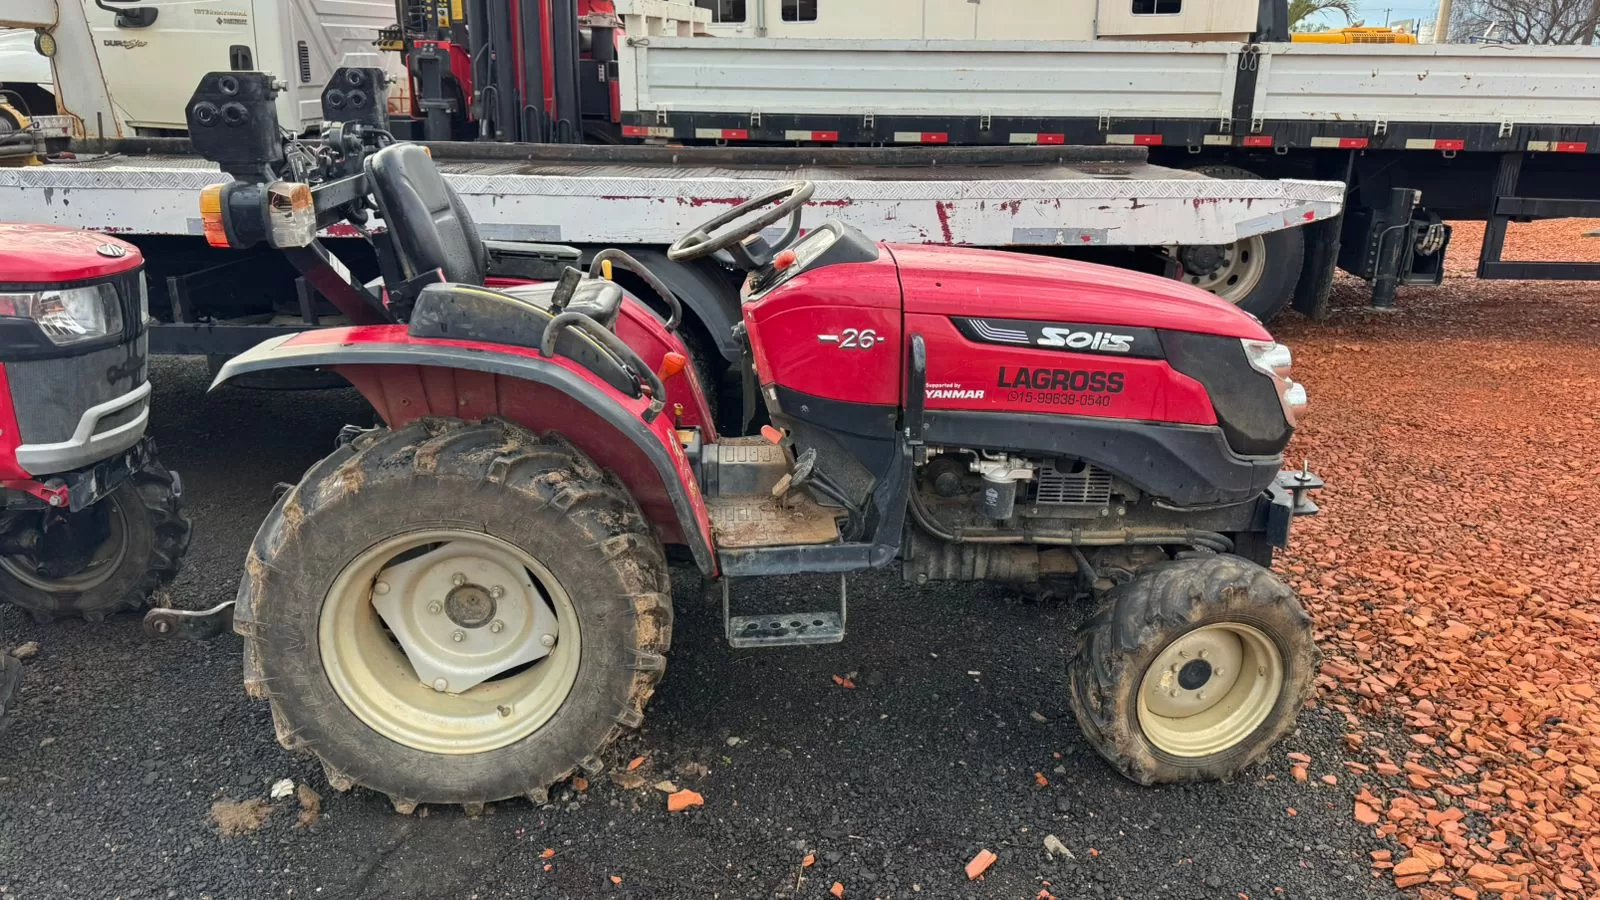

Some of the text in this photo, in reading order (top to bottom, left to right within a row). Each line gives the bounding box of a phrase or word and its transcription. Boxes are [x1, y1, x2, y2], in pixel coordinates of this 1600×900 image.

[193, 8, 248, 17] INTERNATIONAL
[1036, 326, 1136, 353] Solis
[997, 366, 1126, 394] LAGROSS
[925, 389, 985, 399] YANMAR
[1018, 391, 1111, 407] 15-99638-0540
